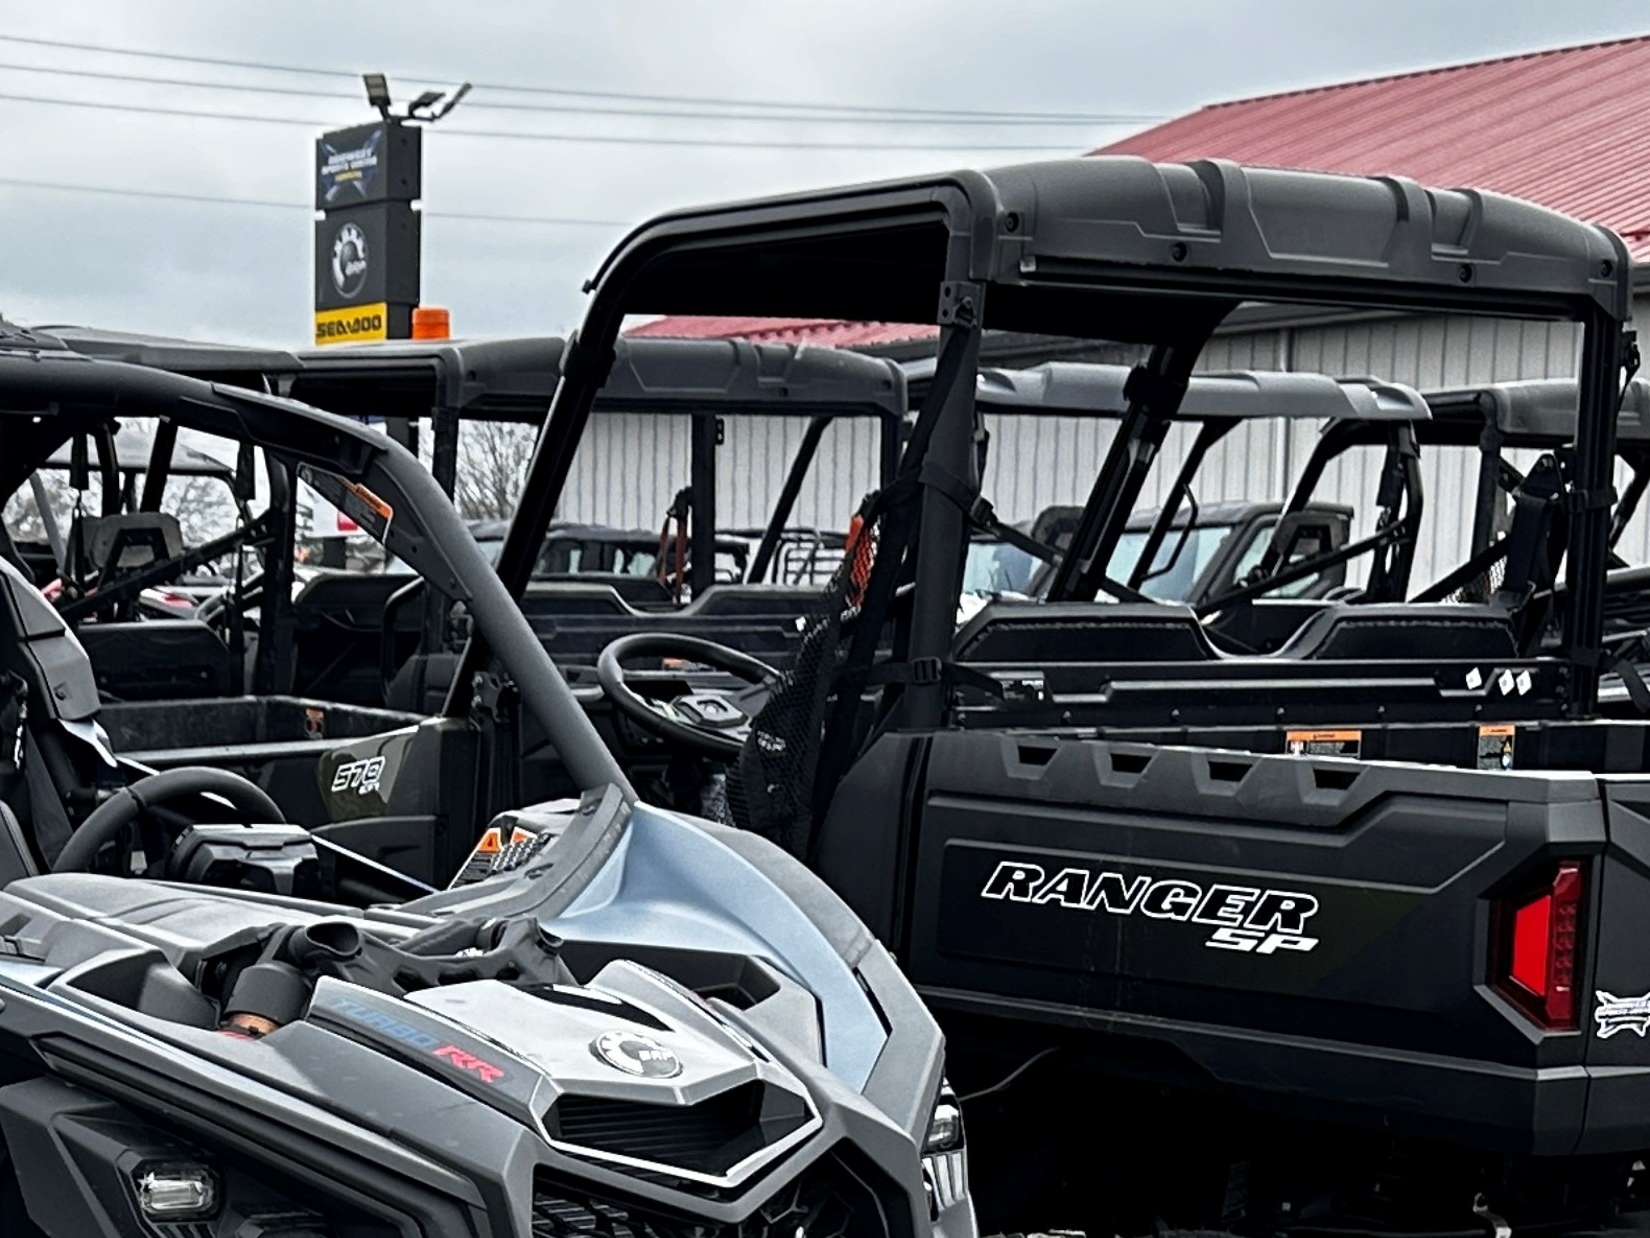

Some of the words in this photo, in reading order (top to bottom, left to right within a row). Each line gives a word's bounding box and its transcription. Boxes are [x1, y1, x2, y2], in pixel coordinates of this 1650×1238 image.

[331, 755, 386, 792] 570
[980, 861, 1320, 935] RANGER
[1205, 927, 1320, 954] SP
[330, 997, 440, 1048] TURBO
[431, 1043, 506, 1084] RR
